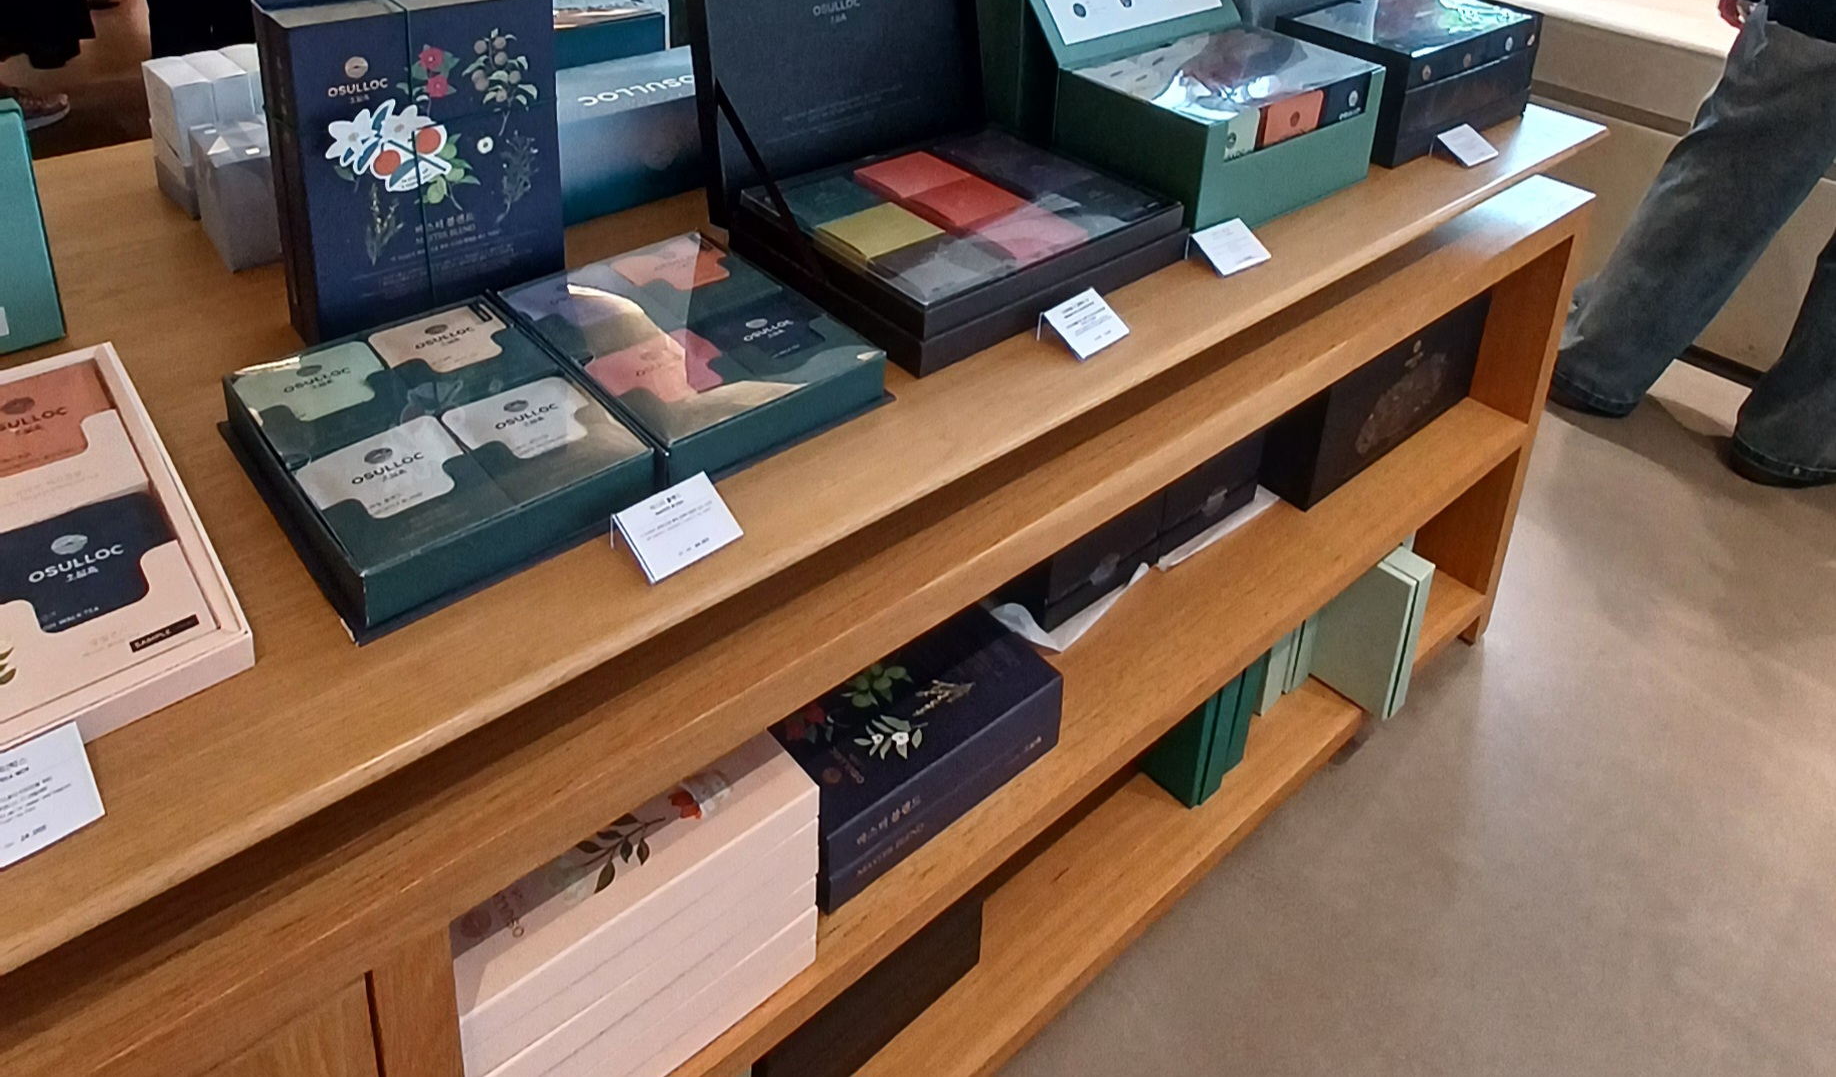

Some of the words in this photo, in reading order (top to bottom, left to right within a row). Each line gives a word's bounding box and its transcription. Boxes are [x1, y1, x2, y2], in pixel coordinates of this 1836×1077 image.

[327, 77, 389, 98] OSULLOC
[577, 74, 695, 107] OSULLOC
[414, 325, 475, 350] OSULLOC
[283, 366, 351, 394] OSULLOC
[495, 402, 559, 431] OSULLOC
[351, 451, 425, 485] OSULLOC
[28, 543, 125, 584] OSULLOC
